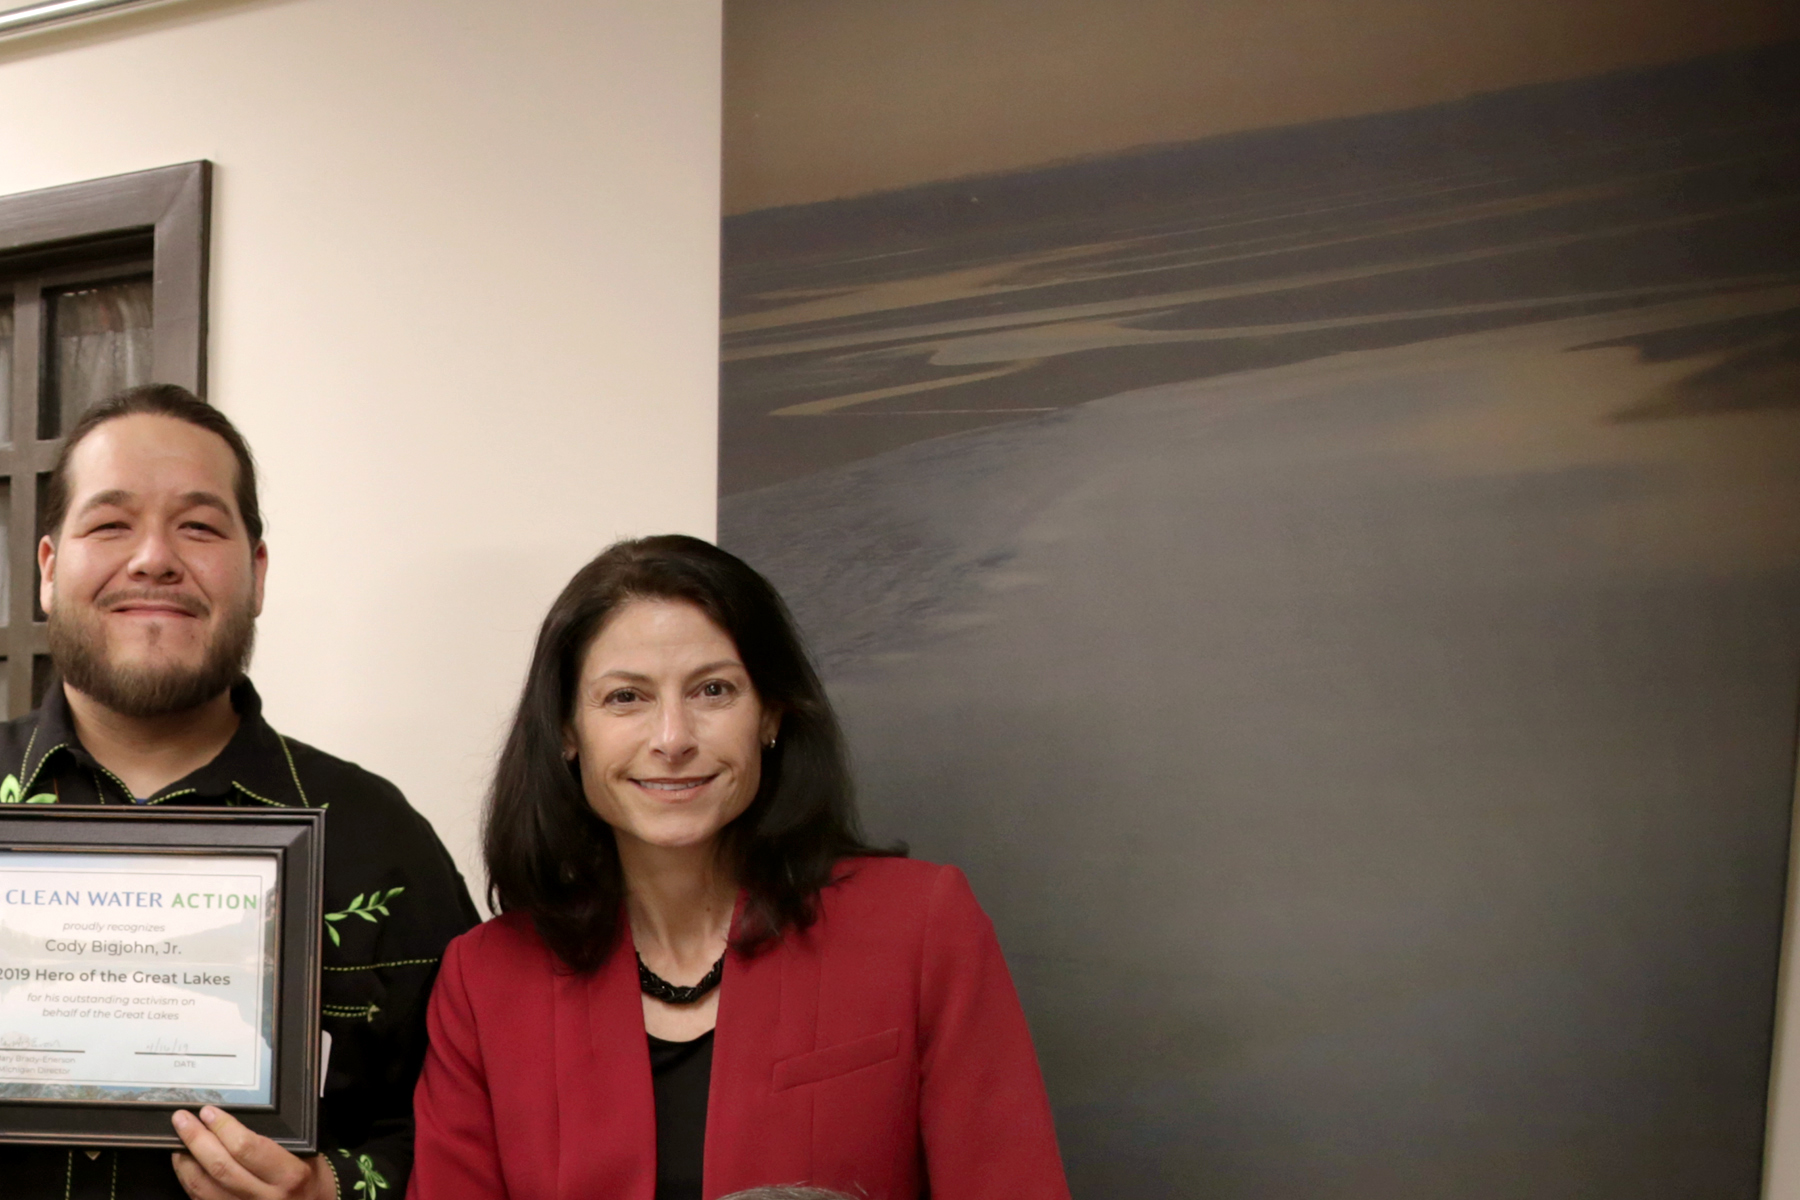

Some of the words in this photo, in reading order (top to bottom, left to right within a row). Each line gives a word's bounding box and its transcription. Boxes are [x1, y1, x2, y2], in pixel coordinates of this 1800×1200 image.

[5, 889, 80, 906] CLEAN
[87, 891, 163, 908] WATER
[171, 893, 257, 909] ACTION
[62, 921, 105, 932] proudly
[107, 923, 165, 933] recognizes
[45, 939, 87, 955] Cody
[91, 940, 158, 956] Bigjohn,
[163, 942, 182, 955] Jr.
[35, 969, 75, 982] Hero
[79, 969, 96, 982] of
[100, 970, 127, 983] the
[133, 971, 178, 984] Great
[183, 972, 231, 985] Lakes
[26, 993, 42, 1003] for
[44, 993, 60, 1003] his
[62, 994, 130, 1006] outstanding
[132, 996, 179, 1006] activism
[181, 998, 196, 1006] on
[42, 1008, 78, 1018] behalf
[79, 1008, 92, 1018] of
[93, 1009, 111, 1019] the
[113, 1009, 144, 1020] Great
[147, 1010, 179, 1021] Lakes
[173, 1060, 197, 1068] DATE
